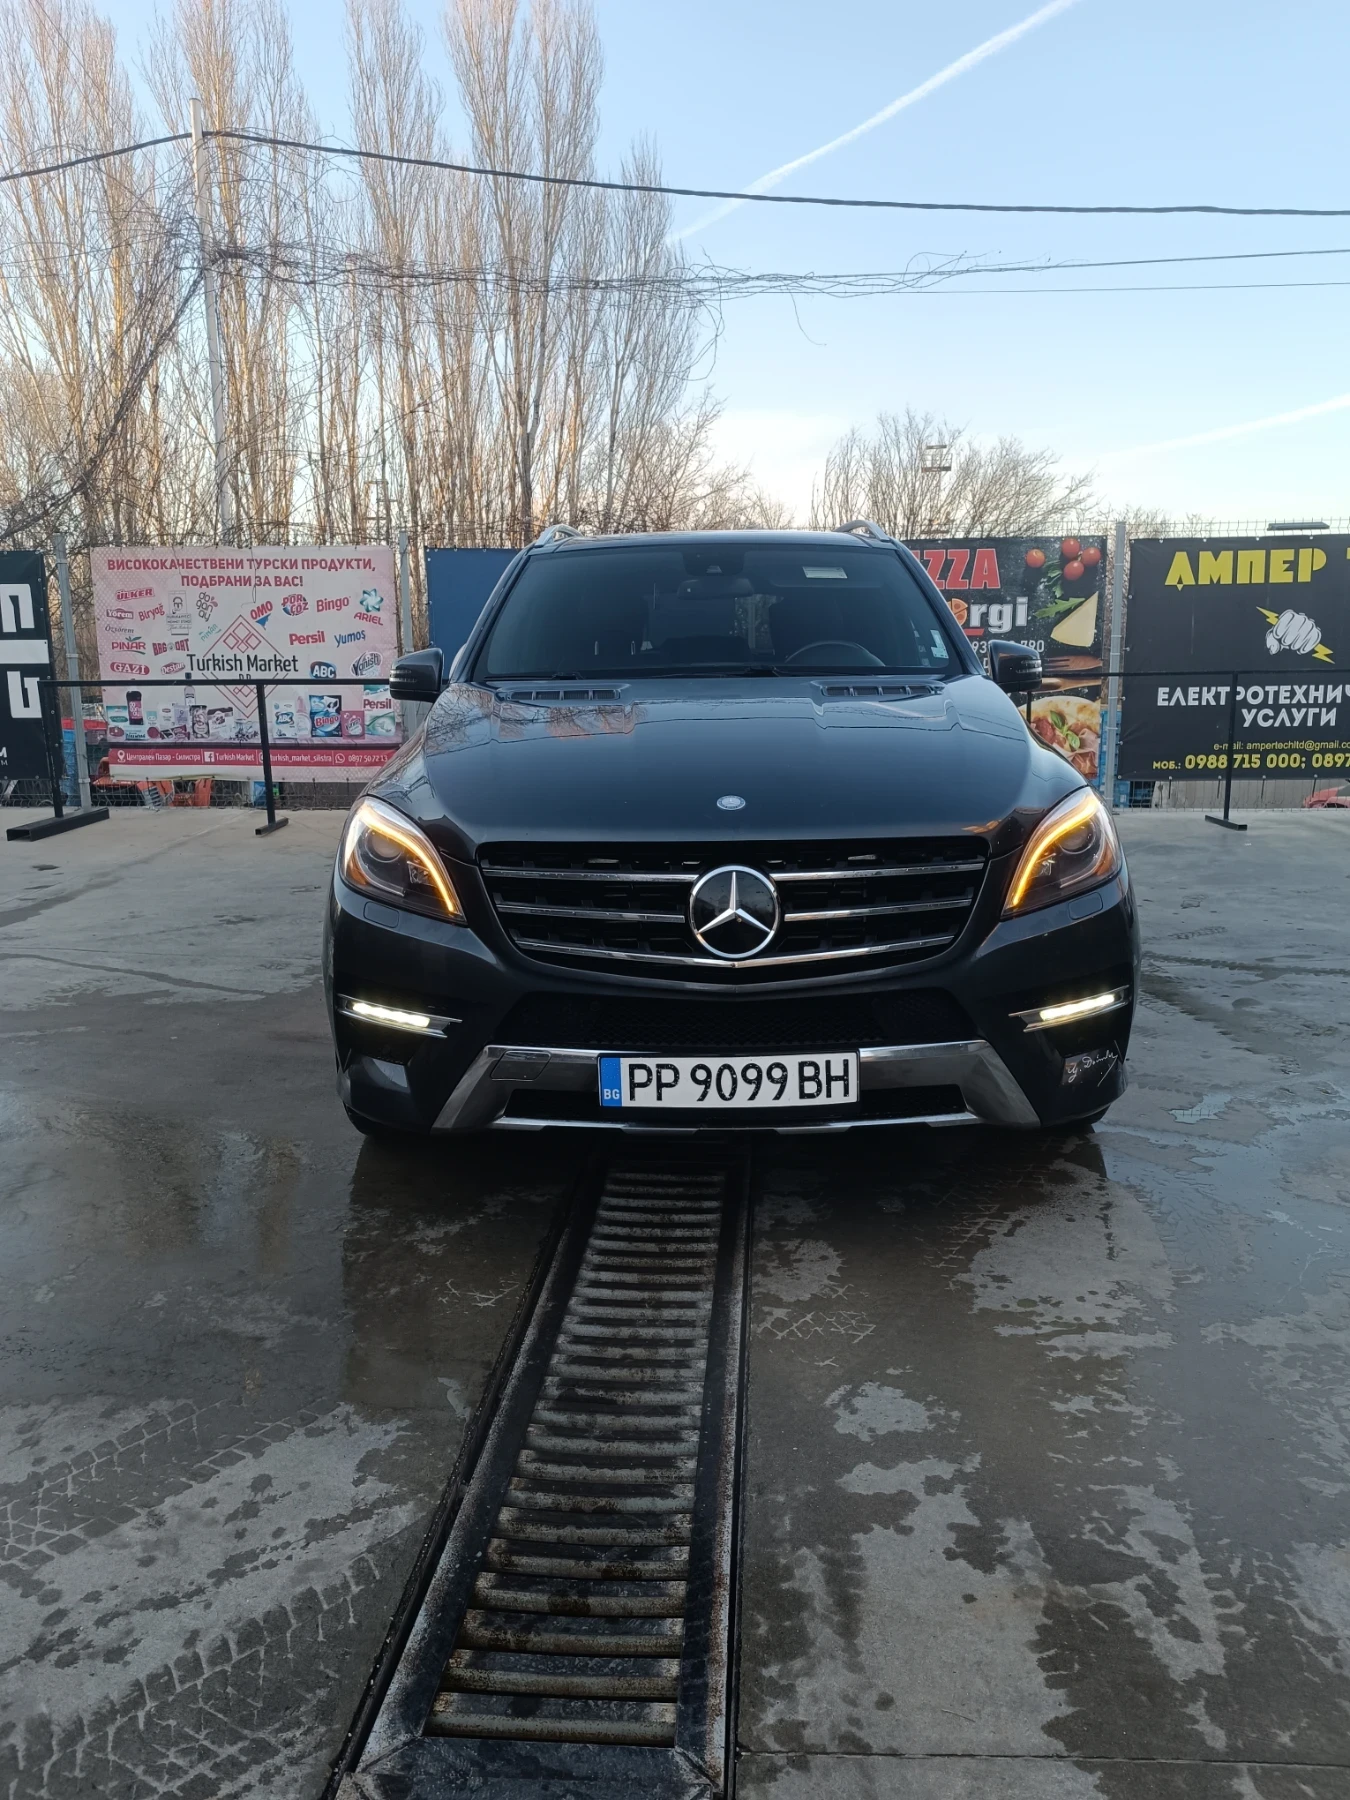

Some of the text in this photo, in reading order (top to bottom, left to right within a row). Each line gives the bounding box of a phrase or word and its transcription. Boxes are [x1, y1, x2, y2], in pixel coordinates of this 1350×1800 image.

[107, 558, 376, 572] ВИСОКОКАЧЕСТВЕНИ ТУРСКИ ПРОДУКТИ,
[912, 548, 1001, 590] ZZA
[1165, 548, 1327, 591] АМПЕР
[181, 575, 304, 588] ПОДБРАНИ ЗА ВАС!
[116, 588, 154, 601] ÜLKER
[250, 600, 274, 620] OMO
[316, 596, 350, 613] Bingo
[353, 611, 384, 626] ARIEL
[289, 630, 326, 645] Persil
[111, 641, 146, 650] PINAR
[186, 653, 299, 672] Turkish Market
[351, 651, 380, 677] Vanish
[313, 664, 335, 678] ABC
[363, 698, 392, 709] Persil
[315, 715, 339, 728] Bingo
[1241, 707, 1337, 727] УСЛУГИ
[216, 753, 255, 761] Turkish Market
[1184, 754, 1228, 769] 0988
[1233, 753, 1261, 768] 715
[1266, 753, 1306, 769] 000;
[628, 1058, 850, 1102] PP 9099 BH
[603, 1089, 620, 1100] BG
